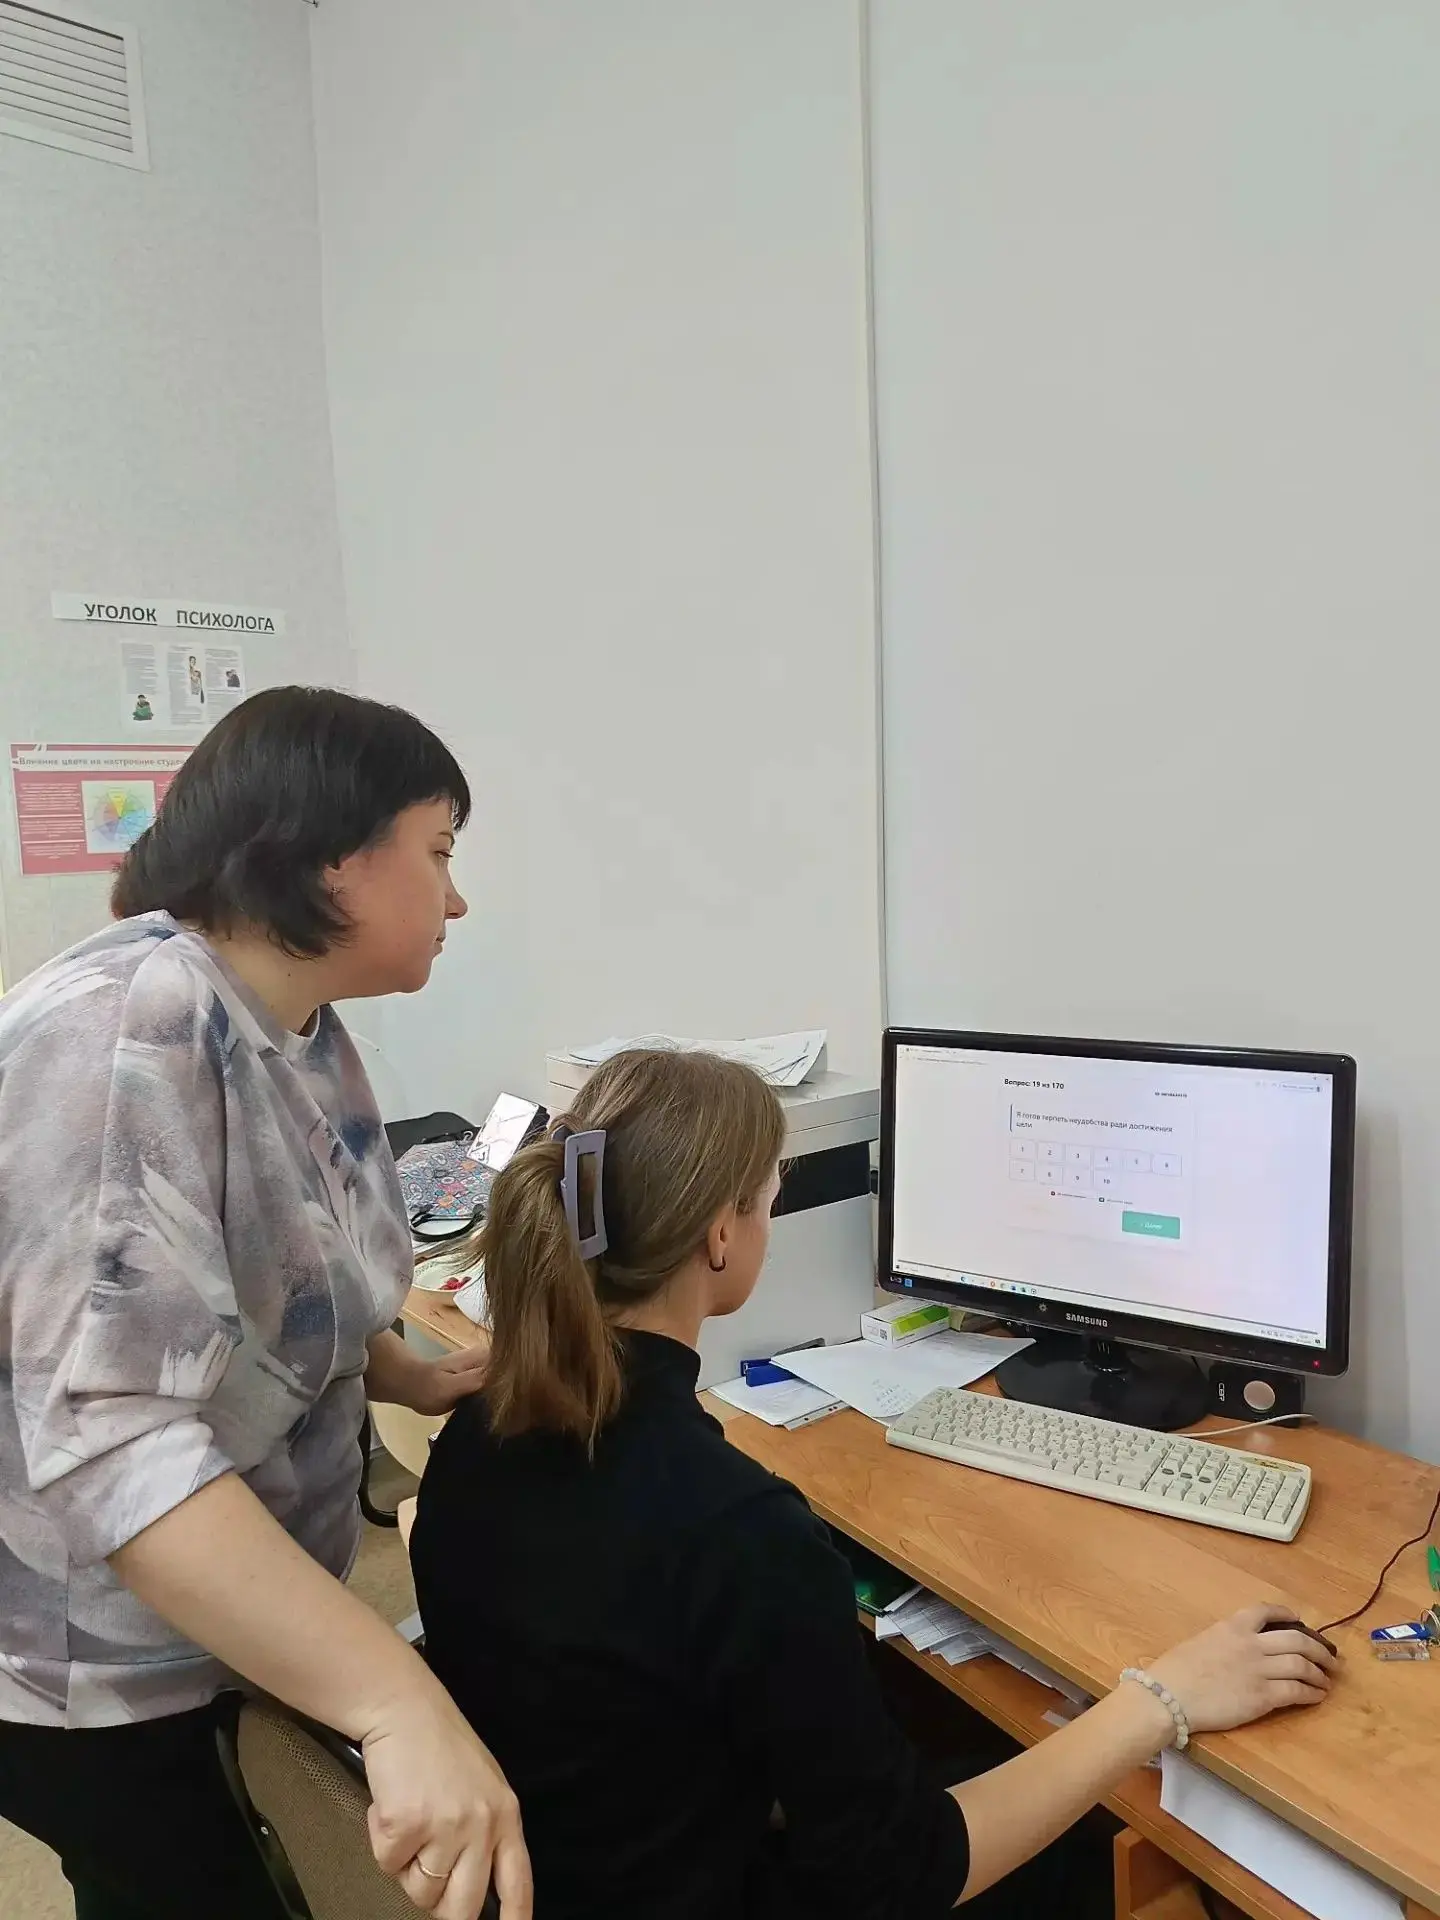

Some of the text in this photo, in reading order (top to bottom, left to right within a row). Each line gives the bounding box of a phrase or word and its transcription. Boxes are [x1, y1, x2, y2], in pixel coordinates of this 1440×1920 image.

[84, 603, 275, 632] УГОЛОК ПСИХОЛОГА
[1052, 1082, 1065, 1090] 170
[1022, 1112, 1041, 1121] готов
[1069, 1117, 1109, 1127] неудобства
[1110, 1120, 1128, 1129] ради
[1129, 1122, 1173, 1133] достижения
[1065, 1312, 1108, 1328] SAMSUNG
